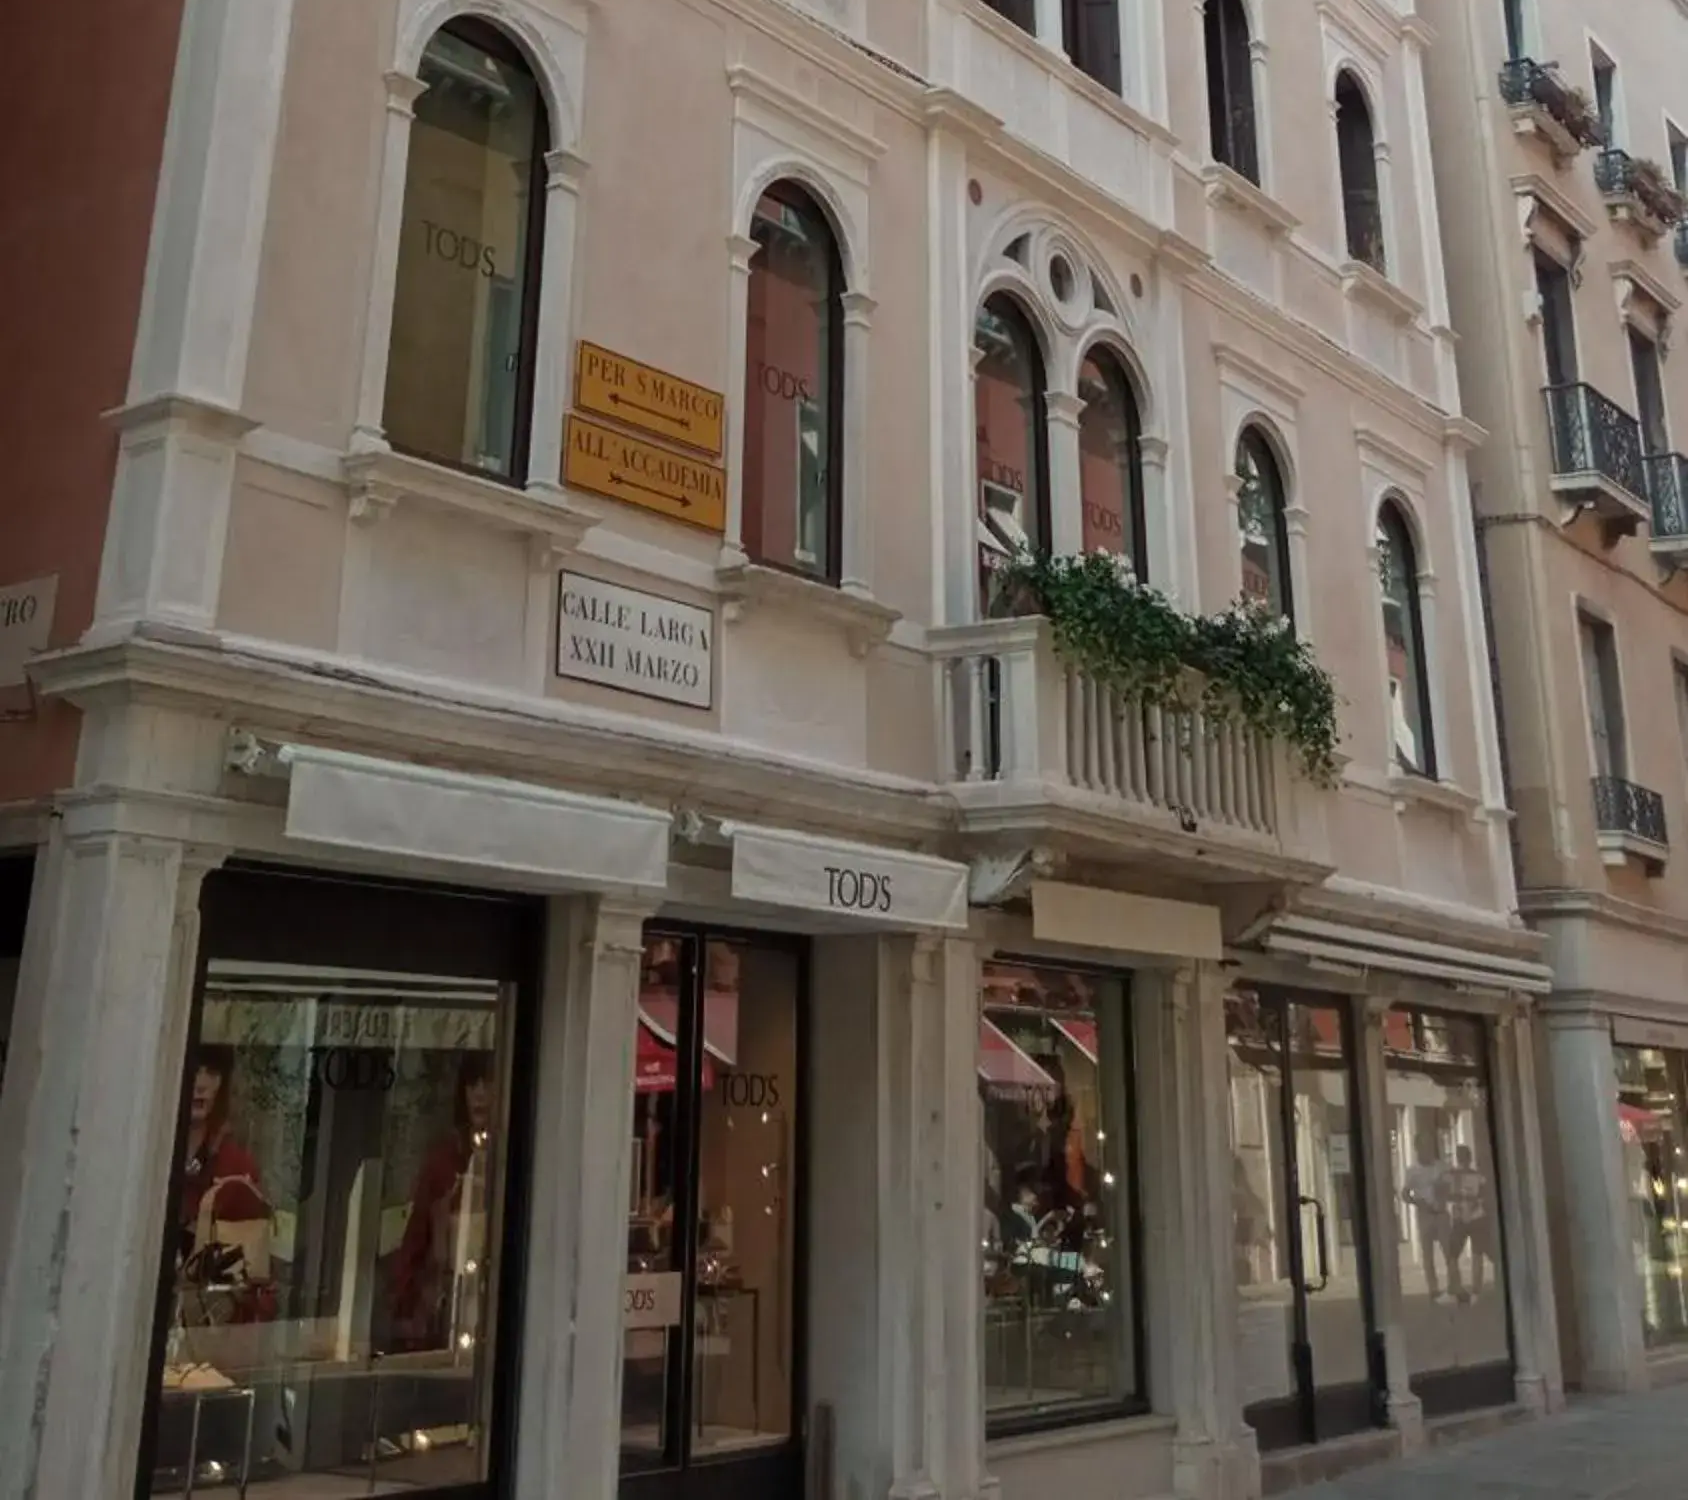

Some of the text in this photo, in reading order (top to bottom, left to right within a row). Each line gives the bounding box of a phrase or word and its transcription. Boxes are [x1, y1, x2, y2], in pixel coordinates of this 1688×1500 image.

[587, 352, 626, 388] PER
[651, 377, 719, 421] MARCO
[0, 594, 37, 628] RO
[562, 591, 709, 652] CALLE LARGA
[570, 634, 700, 689] XXII MARZO
[824, 866, 892, 912] TOD'S
